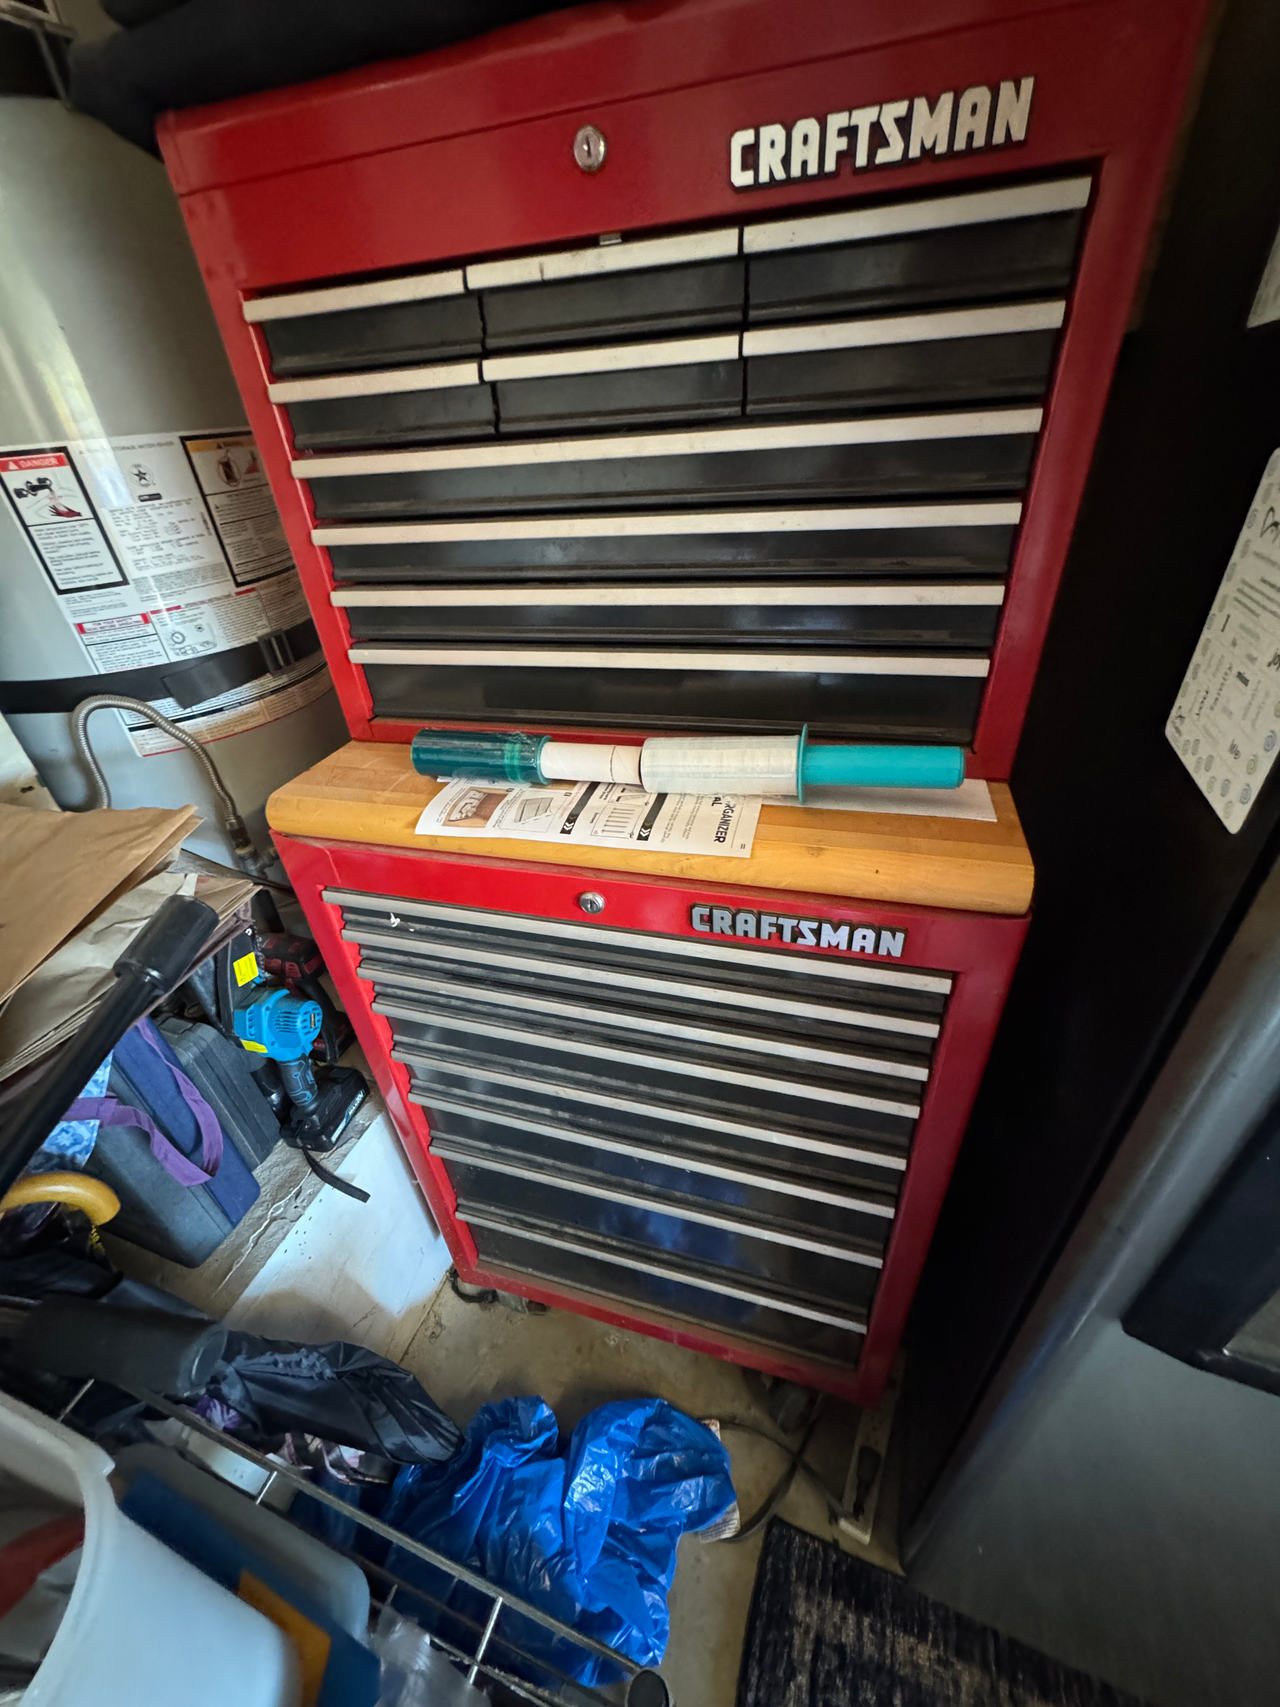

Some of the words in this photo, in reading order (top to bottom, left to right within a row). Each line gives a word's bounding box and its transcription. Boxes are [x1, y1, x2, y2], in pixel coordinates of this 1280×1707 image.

[729, 75, 1035, 189] CRAFTSMAN
[713, 800, 737, 844] RGANIZER
[691, 904, 906, 958] CRAFTSMAN
